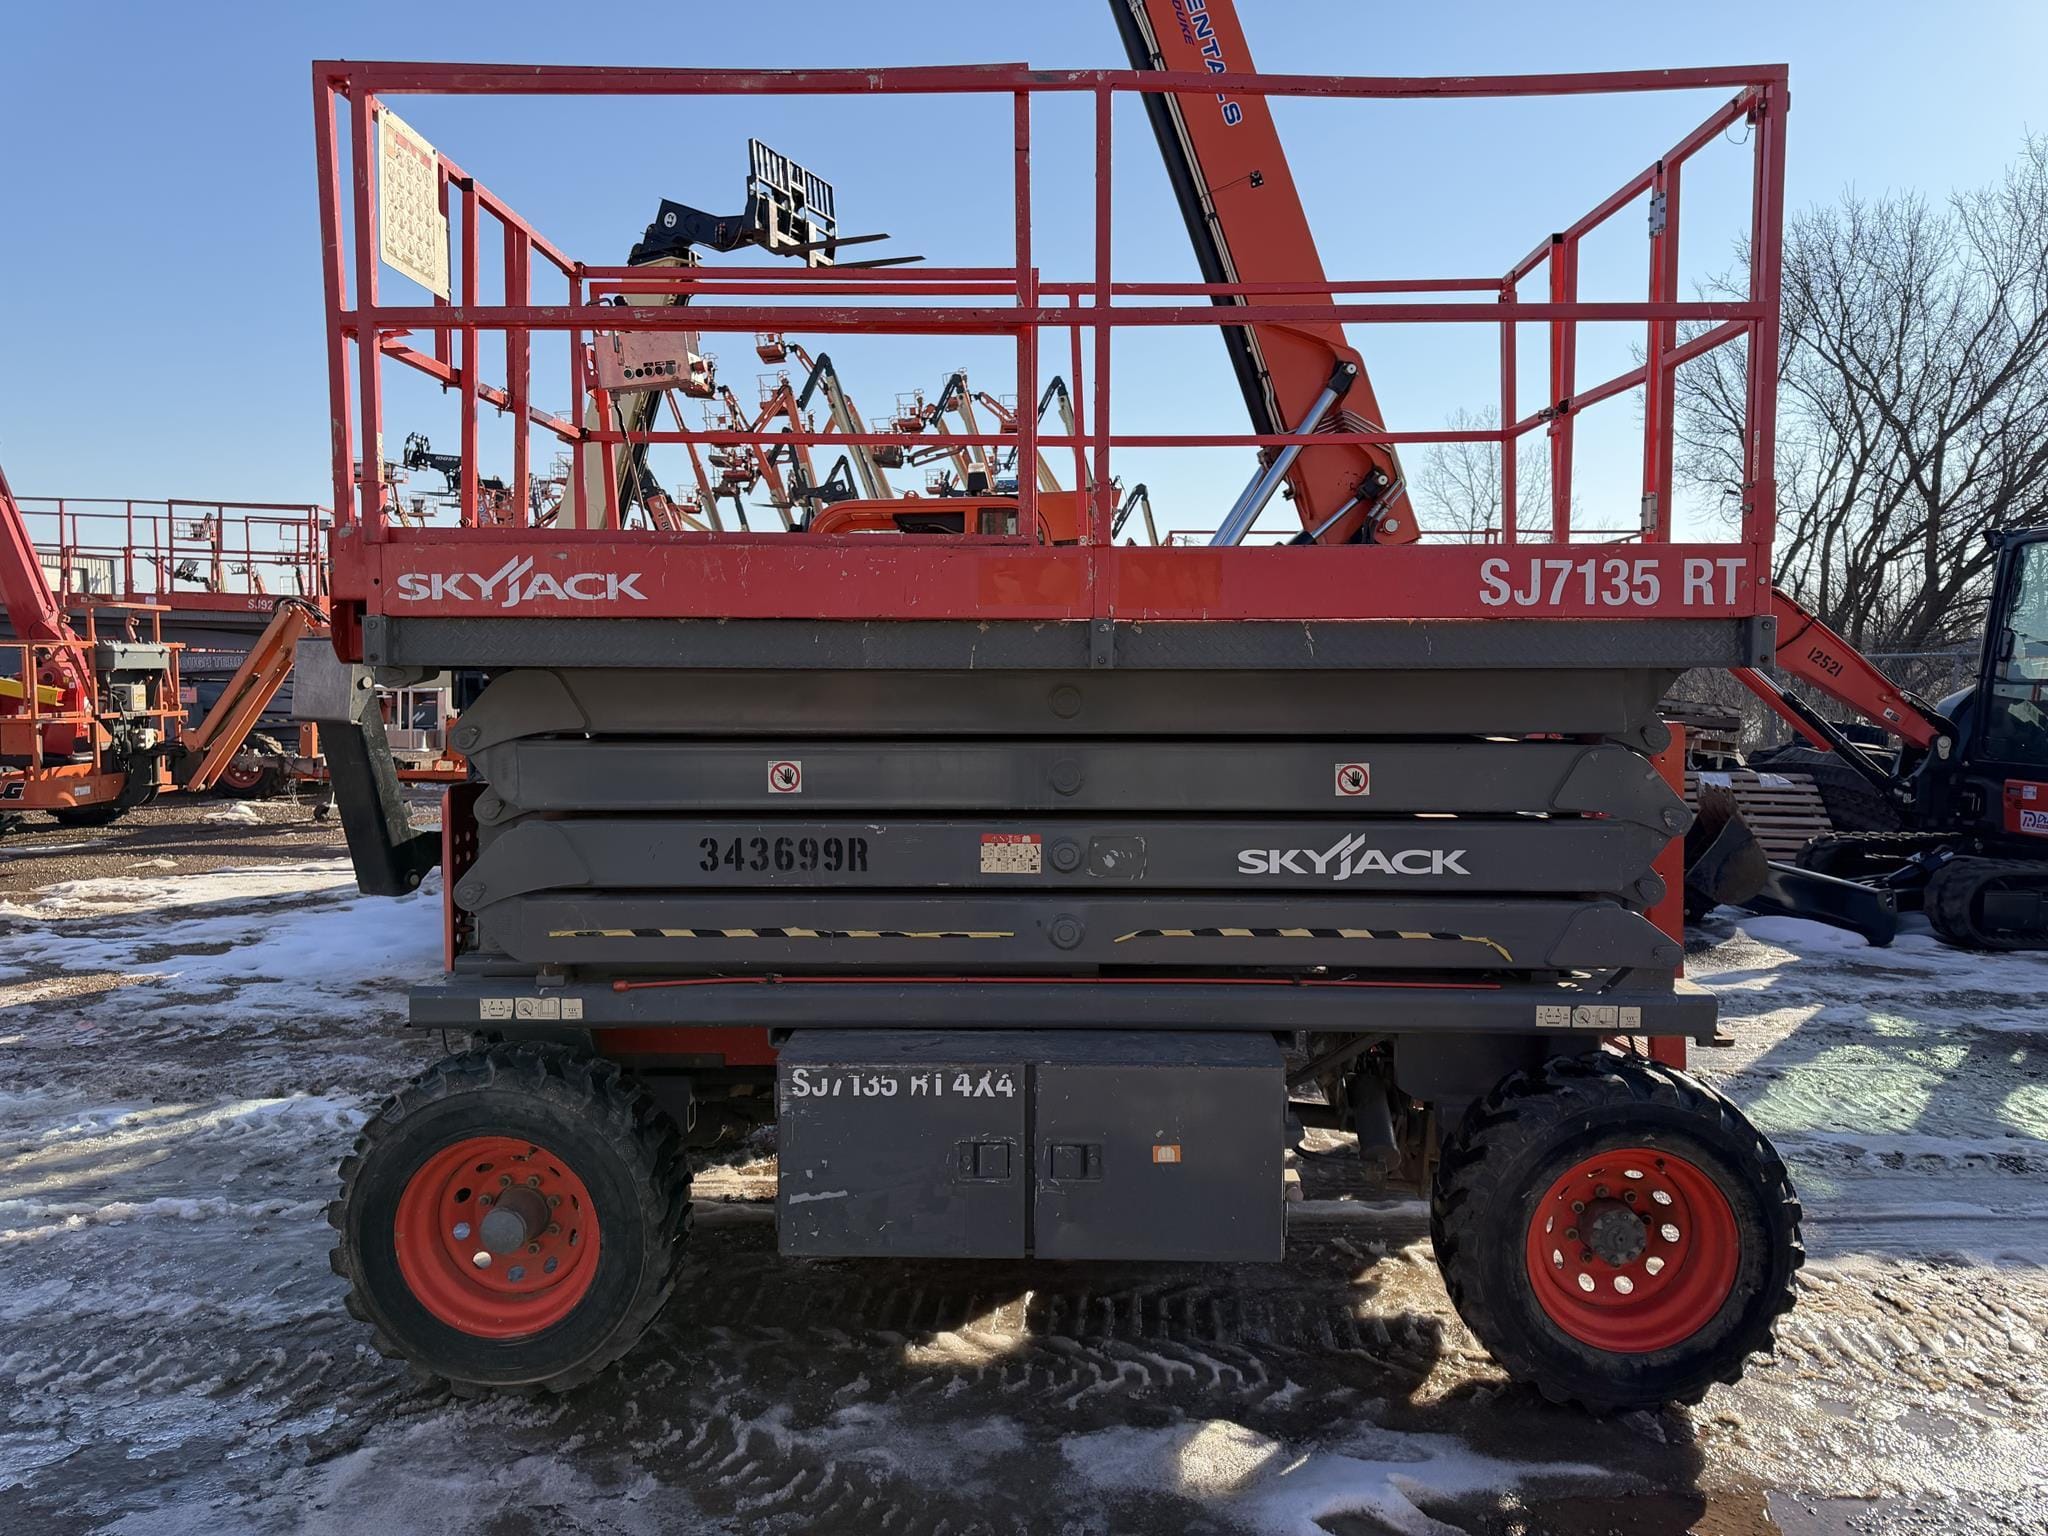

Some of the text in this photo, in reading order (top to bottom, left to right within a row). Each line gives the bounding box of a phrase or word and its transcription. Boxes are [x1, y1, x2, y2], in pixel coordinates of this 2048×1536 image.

[1183, 0, 1243, 127] ENTAS
[247, 598, 275, 611] SJ92
[397, 554, 649, 608] SKYJACK
[1479, 558, 1747, 606] SJ7135 RT
[699, 836, 868, 872] 343699R
[1237, 832, 1472, 881] SKYJACK
